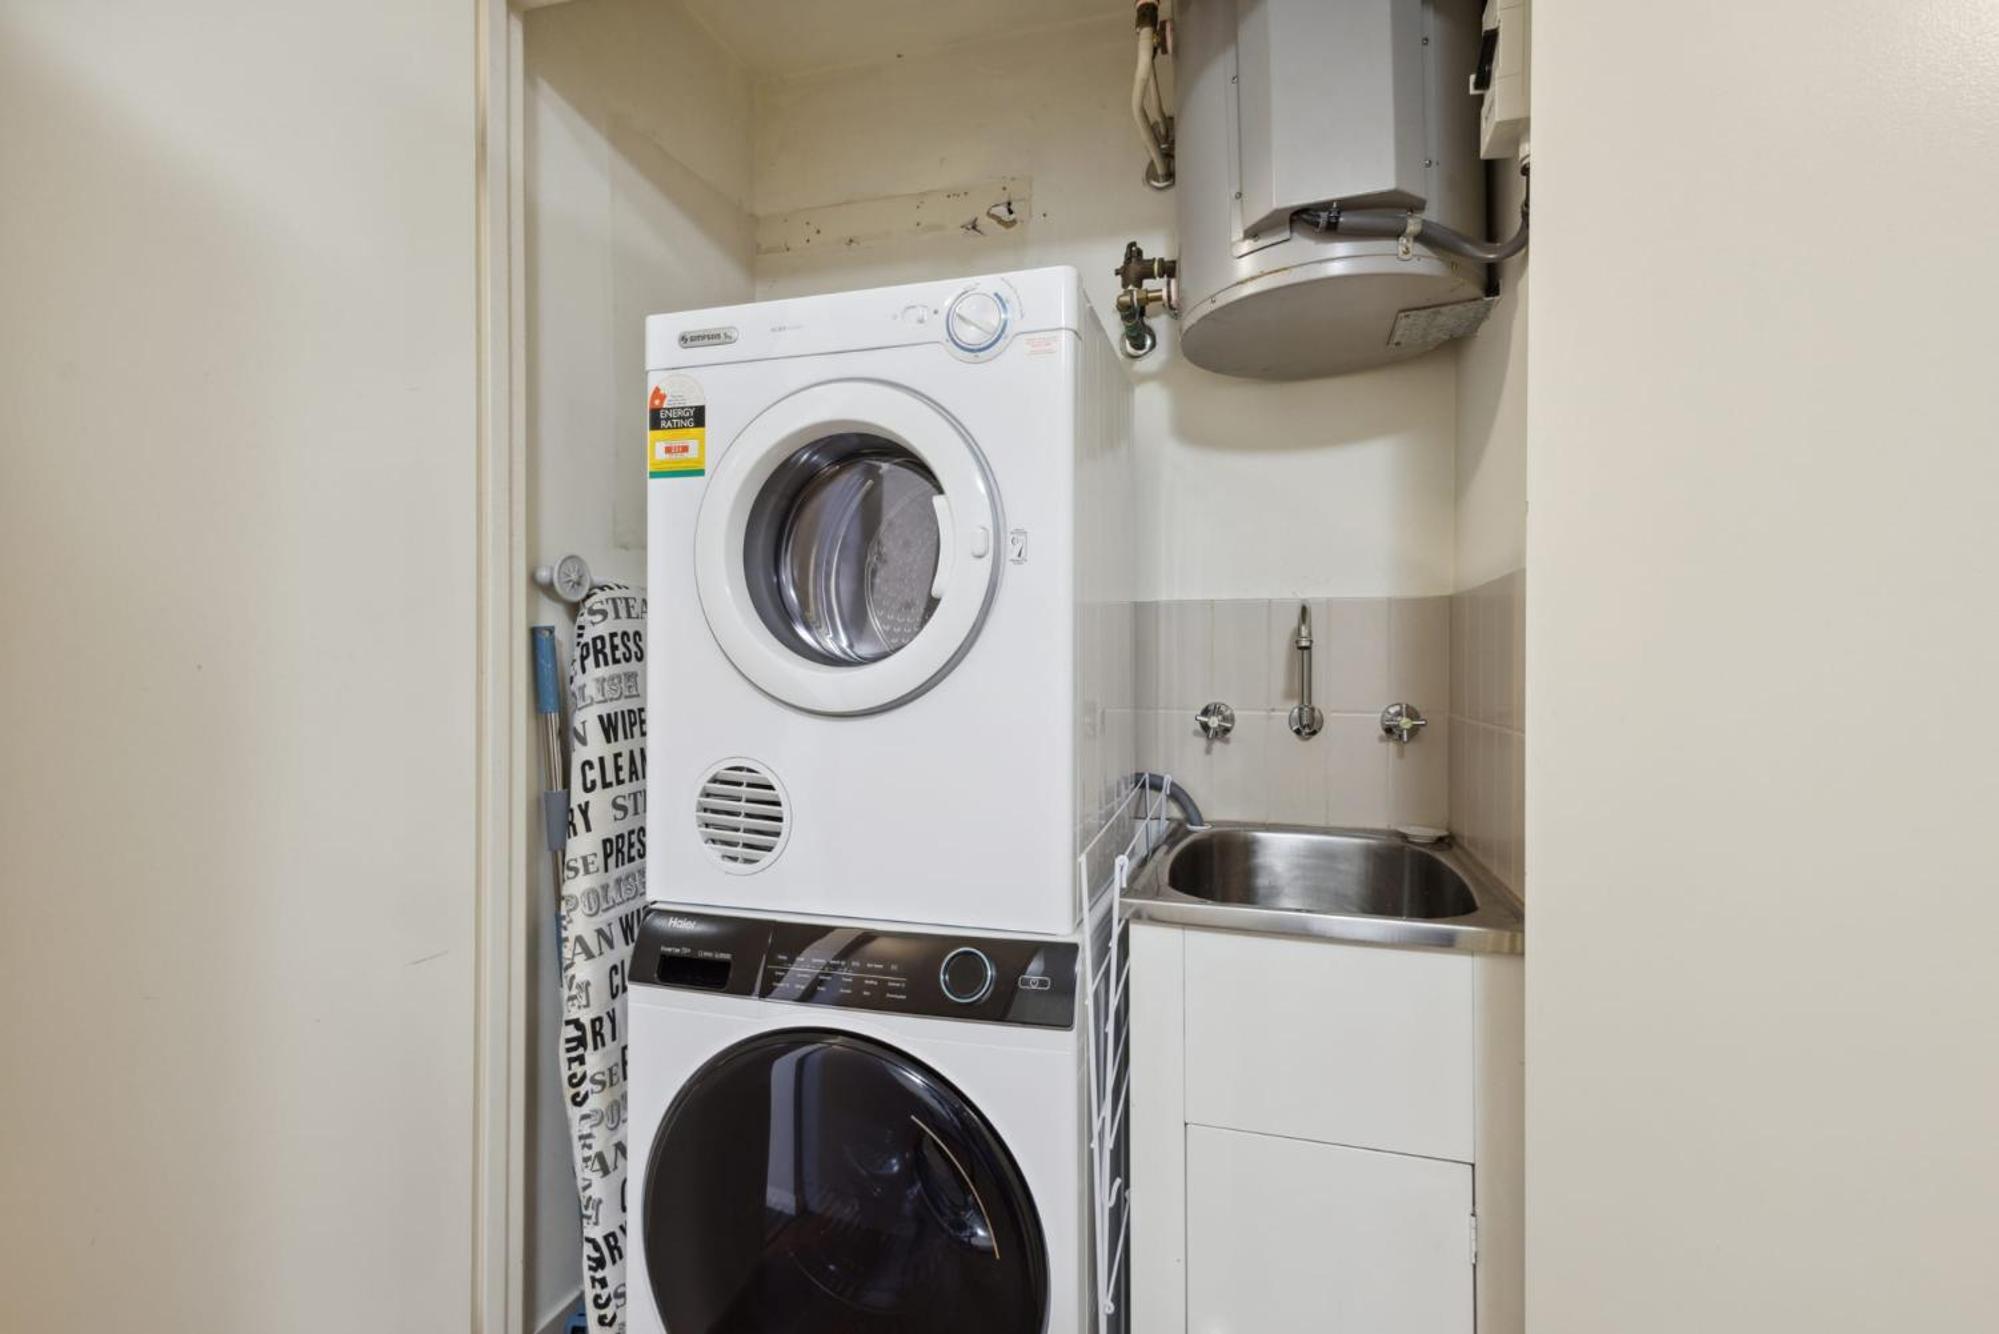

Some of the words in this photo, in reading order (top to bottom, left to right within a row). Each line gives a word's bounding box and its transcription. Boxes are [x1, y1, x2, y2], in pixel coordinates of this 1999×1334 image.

[660, 408, 695, 419] ENERGY
[660, 419, 695, 429] RATING
[580, 630, 645, 675] PRESS
